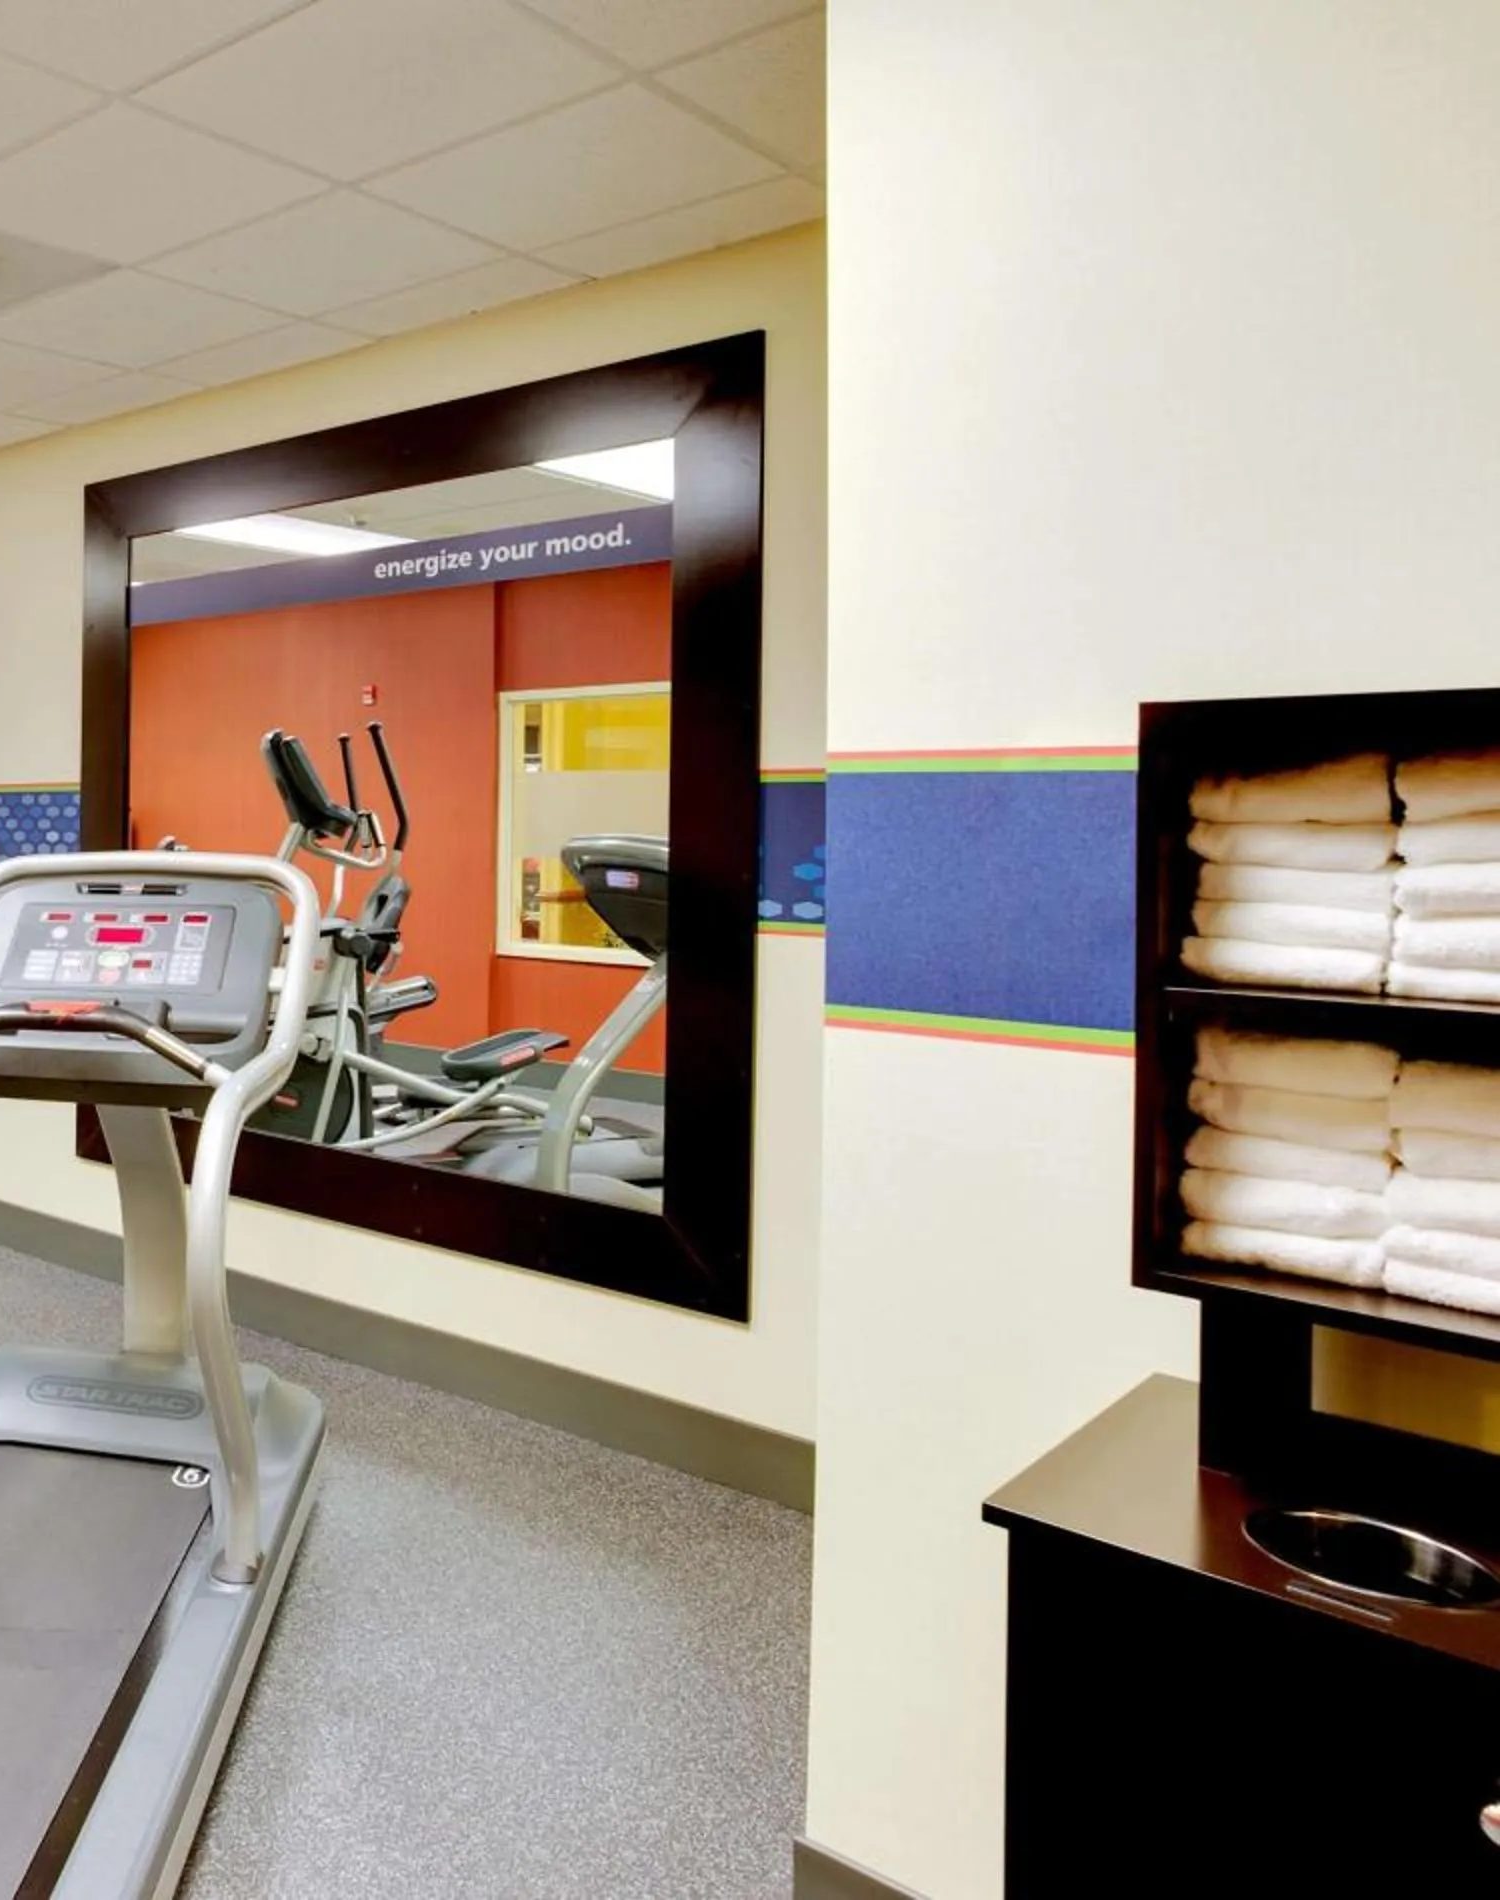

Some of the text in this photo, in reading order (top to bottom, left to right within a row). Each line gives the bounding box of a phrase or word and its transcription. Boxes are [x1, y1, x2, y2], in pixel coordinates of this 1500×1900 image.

[374, 522, 632, 579] energize your mood.
